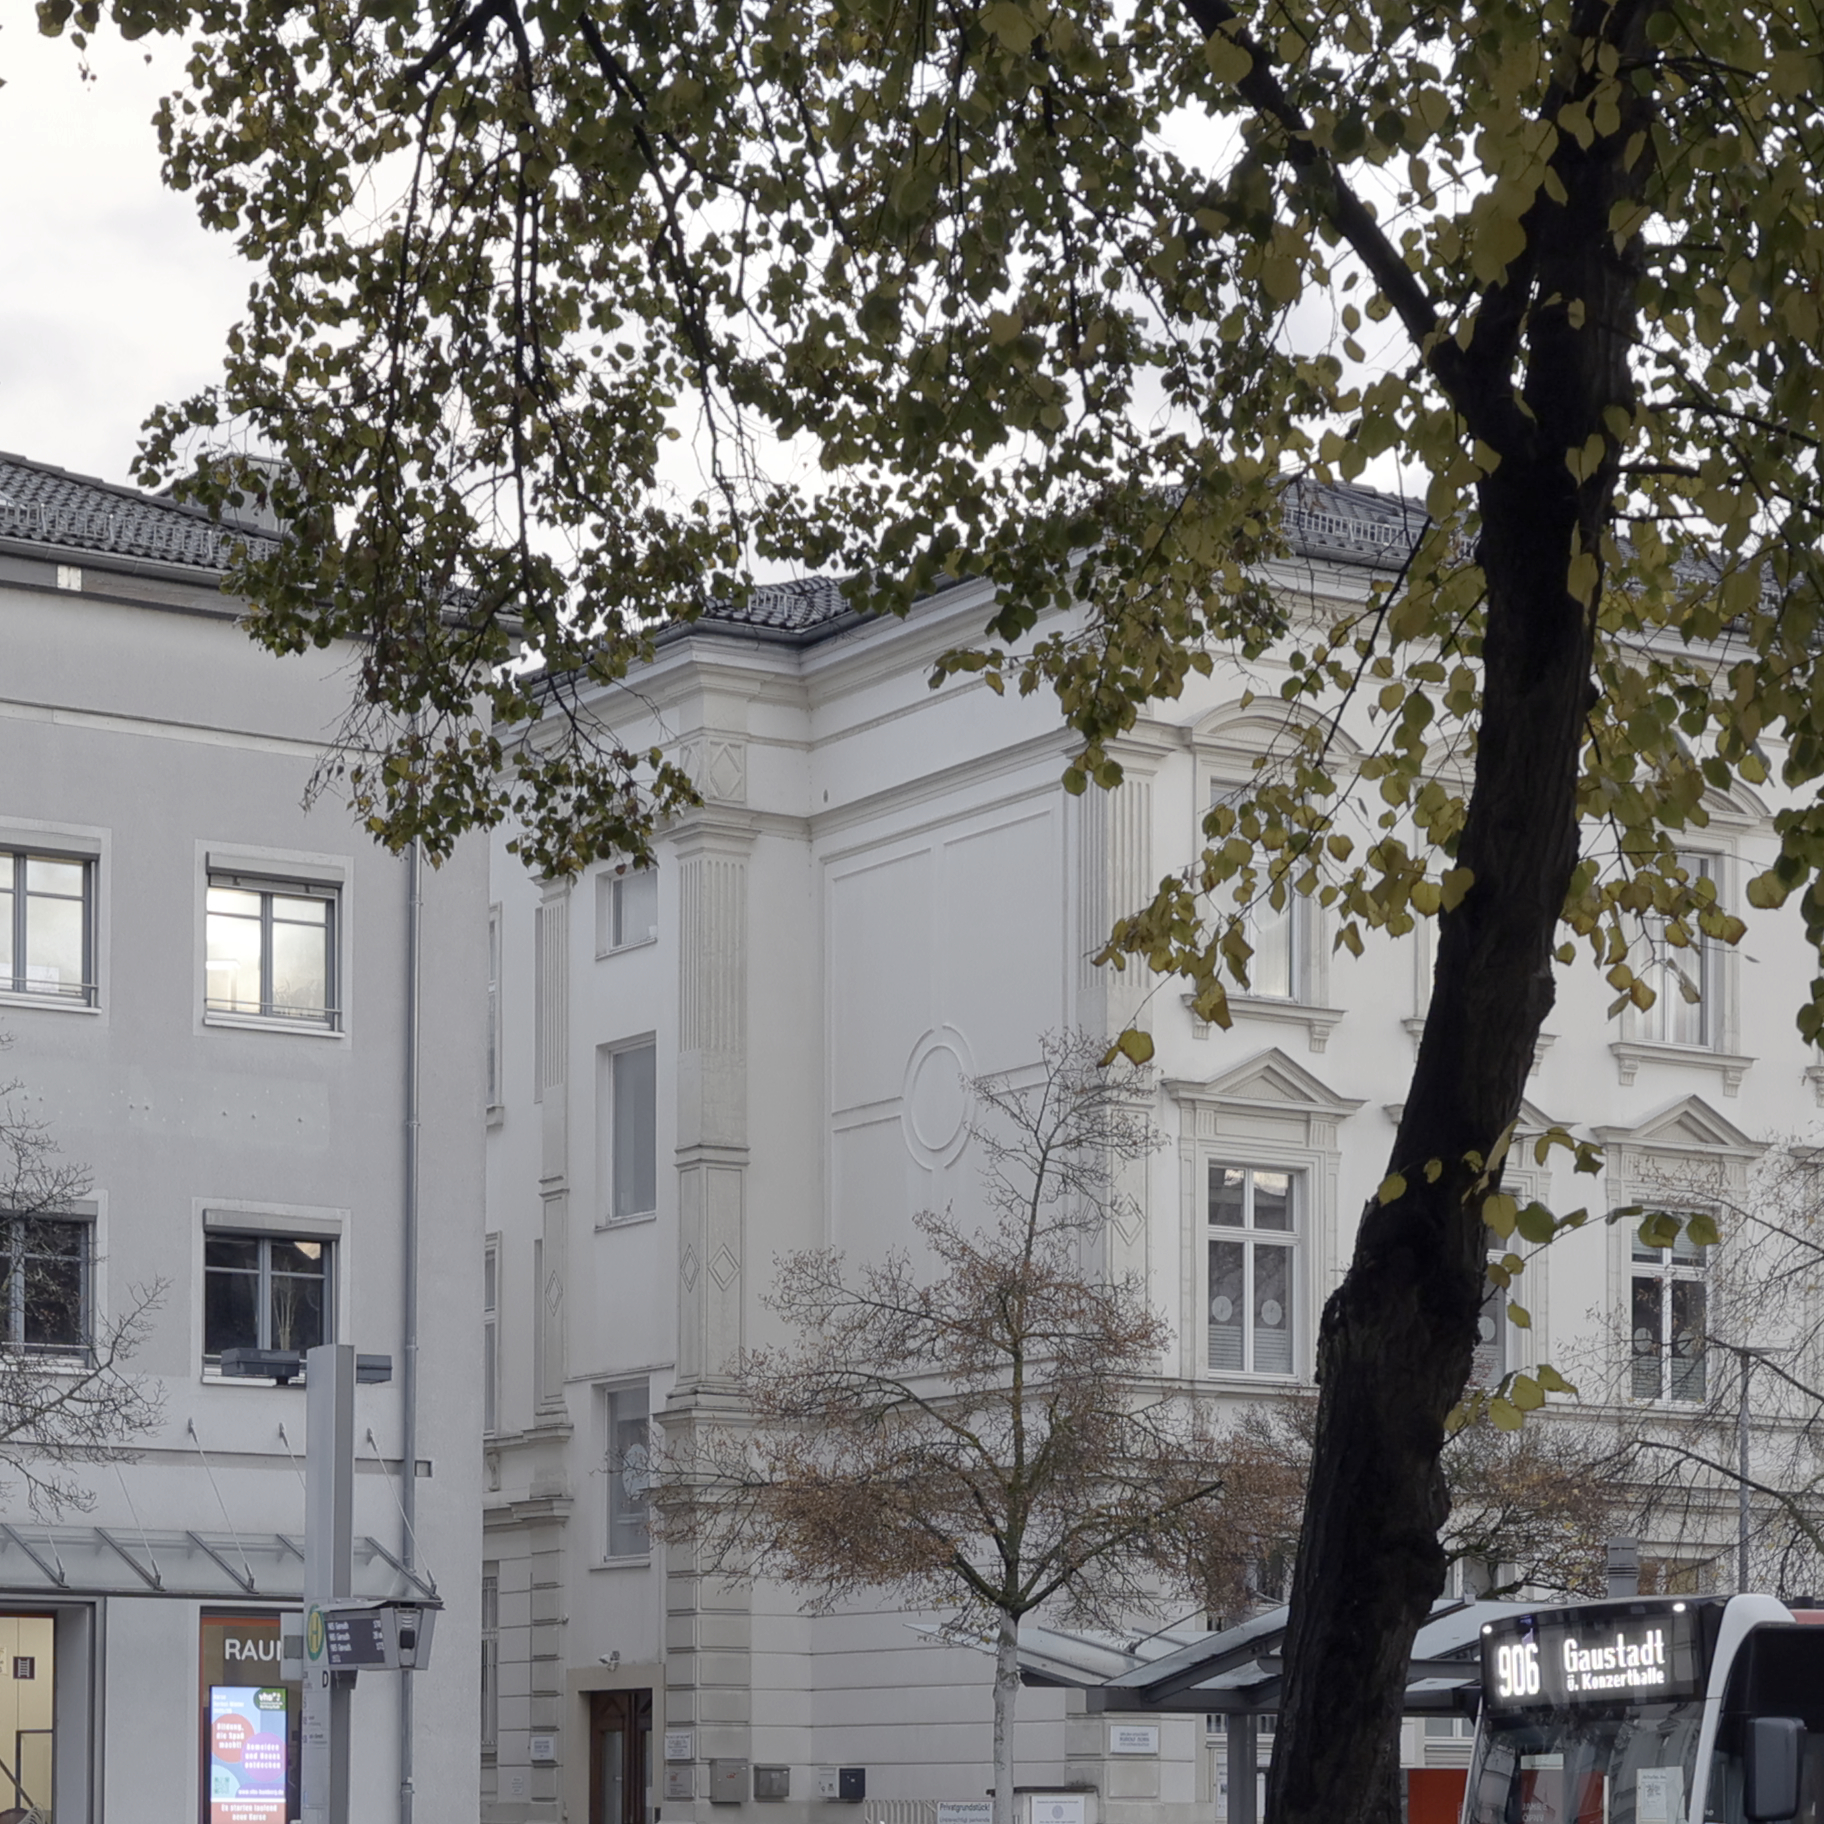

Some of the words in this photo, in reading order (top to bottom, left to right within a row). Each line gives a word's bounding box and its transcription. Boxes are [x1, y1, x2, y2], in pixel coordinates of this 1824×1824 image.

[1563, 1629, 1665, 1672] Gaustadt
[1498, 1643, 1540, 1697] 906
[322, 1670, 329, 1688] D
[1567, 1675, 1579, 1692] ü.
[1581, 1667, 1665, 1691] Konzerthalle
[217, 1723, 244, 1731] Bildung,
[216, 1732, 227, 1740] die
[246, 1743, 280, 1751] Anmelden
[245, 1752, 258, 1760] und
[230, 1804, 253, 1812] starten
[940, 1802, 990, 1813] Privatgrundstück!
